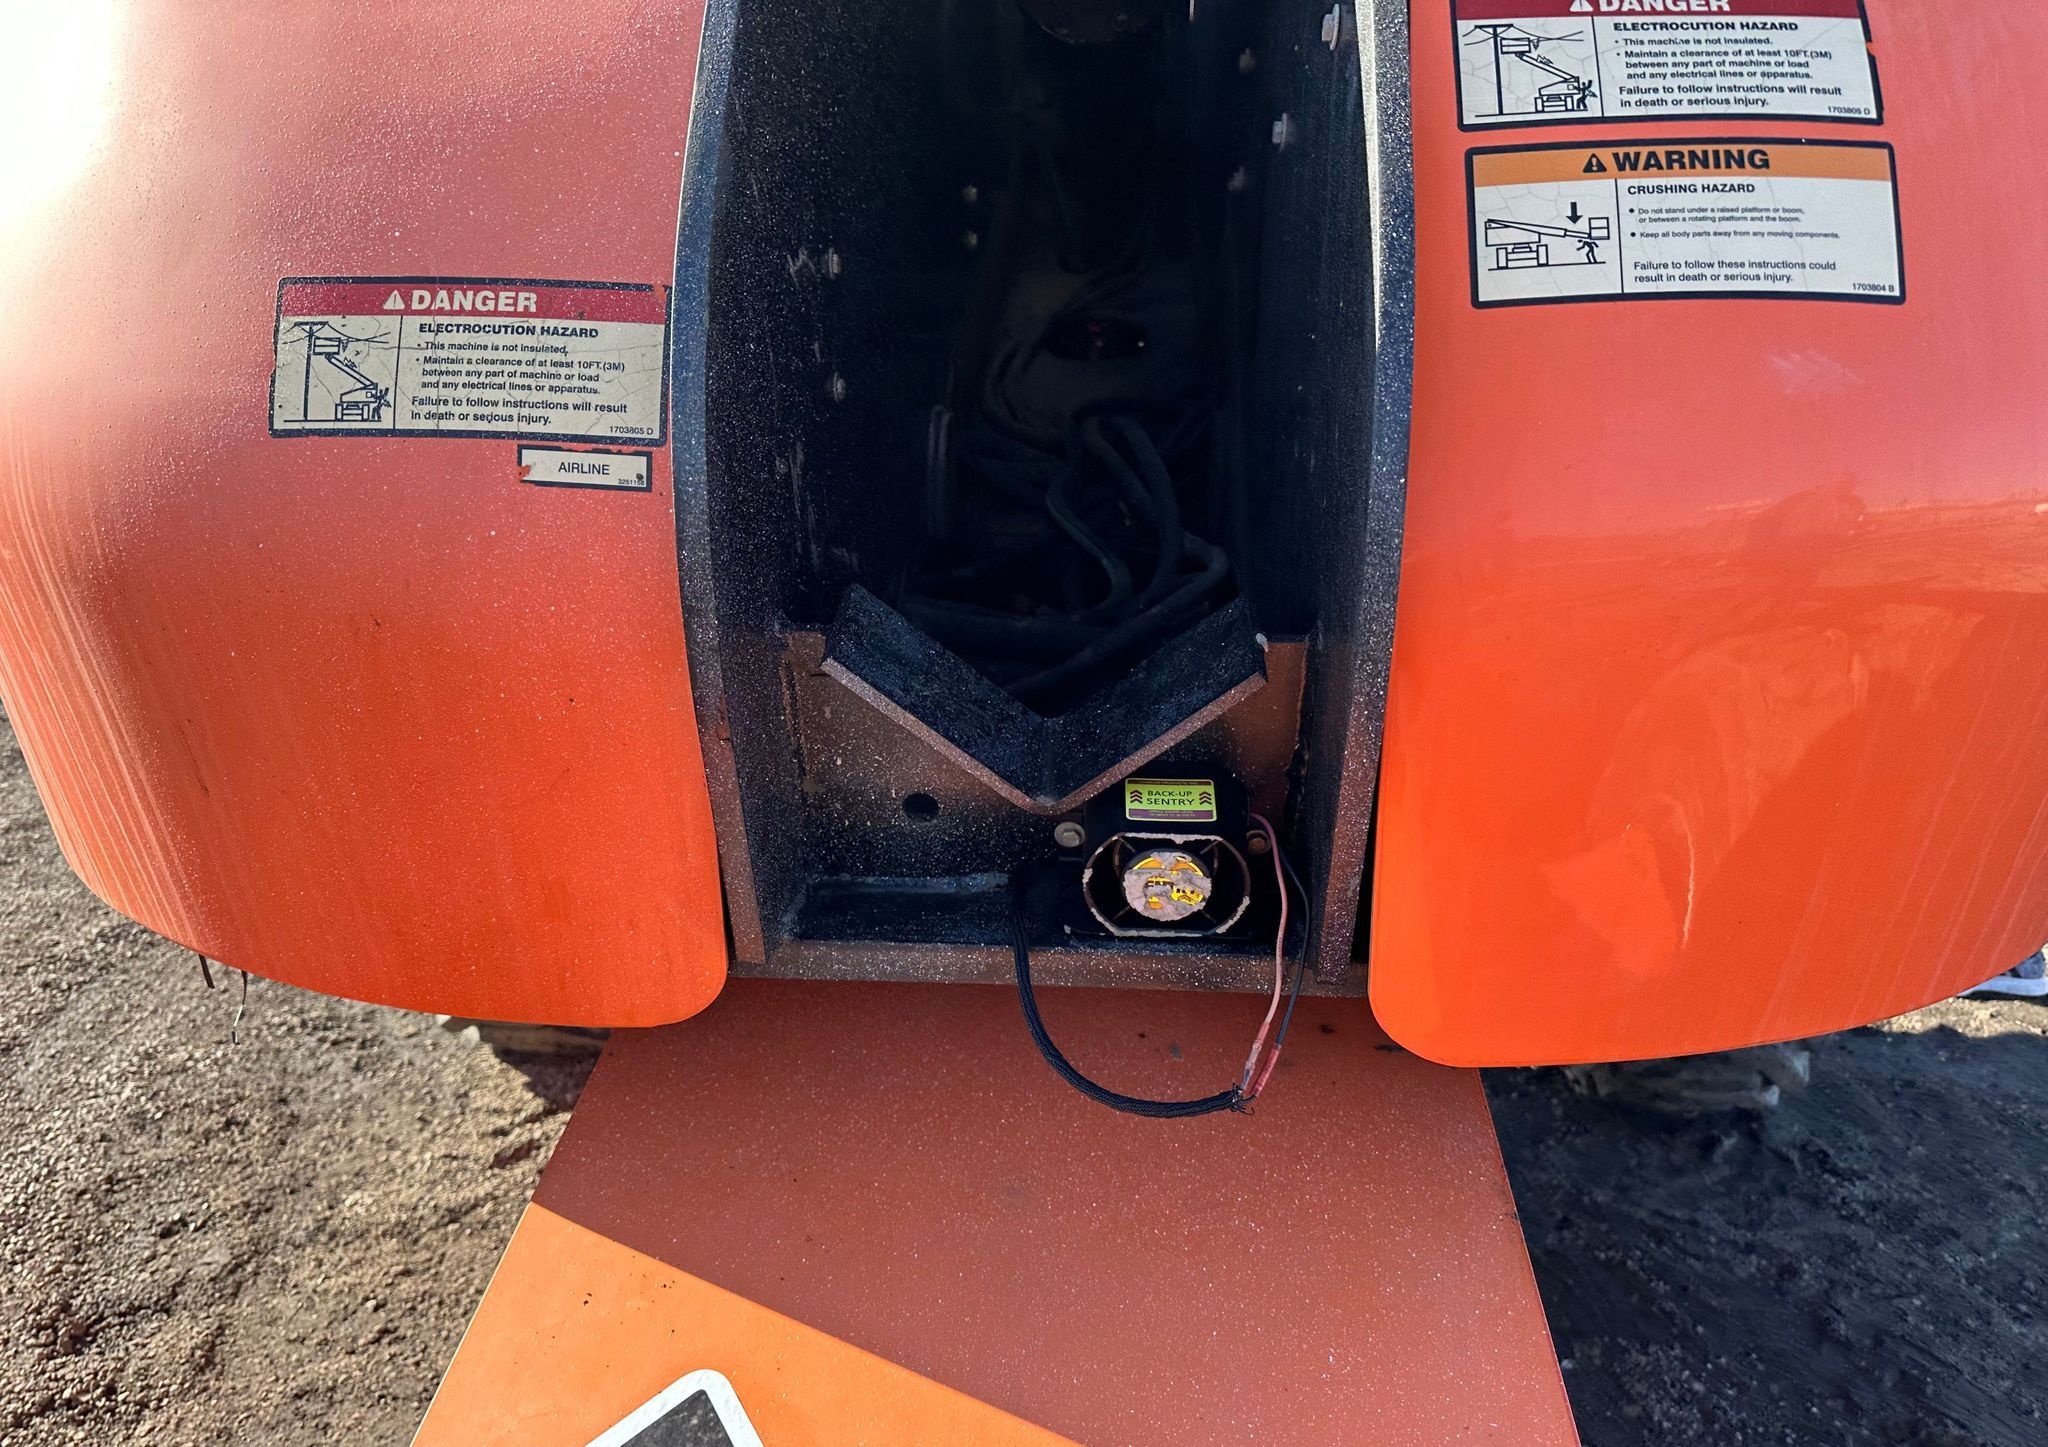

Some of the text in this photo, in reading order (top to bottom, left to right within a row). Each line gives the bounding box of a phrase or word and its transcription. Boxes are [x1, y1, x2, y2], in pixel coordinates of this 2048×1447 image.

[1614, 22, 1798, 31] ELECTROCUTION HAZARD
[1724, 37, 1773, 45] insulated.
[1625, 50, 1668, 58] Maintain
[1680, 49, 1729, 57] clearance
[1757, 49, 1781, 57] least
[1671, 61, 1690, 69] any
[1692, 60, 1713, 68] part
[1788, 60, 1809, 68] load
[1627, 71, 1646, 79] and
[1649, 72, 1667, 80] any
[1670, 70, 1717, 78] electrical
[1720, 70, 1744, 78] lines
[1760, 71, 1813, 79] apparatus.
[1619, 84, 1842, 95] Failure to follow instructions will result
[1620, 97, 1769, 108] in death or serious injury.
[1612, 149, 1770, 172] WARNING
[1628, 183, 1755, 195] CRUSHING HAZARD
[1741, 206, 1771, 214] platform
[1688, 215, 1716, 223] rotating
[1692, 230, 1711, 238] parts
[1634, 260, 1836, 270] Failure to follow these instructions could
[1634, 273, 1663, 283] result
[1666, 273, 1676, 282] in
[1678, 273, 1708, 282] death
[1723, 272, 1761, 282] serious
[1764, 273, 1793, 283] injury.
[1888, 284, 1895, 292] B
[411, 289, 537, 312] DANGER
[419, 323, 599, 338] ELECTROCUTION HAZARD
[425, 341, 445, 350] This
[448, 342, 488, 351] machine
[491, 342, 500, 351] is
[502, 344, 518, 352] not
[423, 356, 464, 365] Maintain
[475, 357, 522, 366] clearance
[525, 358, 536, 366] of
[550, 359, 574, 368] least
[422, 368, 462, 376] between
[465, 370, 485, 379] any
[485, 369, 504, 379] part
[507, 370, 518, 378] of
[519, 371, 562, 380] machine
[578, 373, 599, 381] load
[421, 380, 439, 388] and
[442, 381, 460, 390] any
[462, 380, 506, 390] electrical
[508, 382, 532, 391] lines
[548, 384, 600, 394] apparatus.
[411, 396, 627, 413] Failure to follow instructions will result
[411, 410, 421, 419] in
[424, 411, 454, 420] death
[473, 412, 514, 422] serious
[517, 412, 551, 425] injury.
[558, 462, 610, 475] AIRLINE
[1146, 798, 1195, 806] SENTRY
